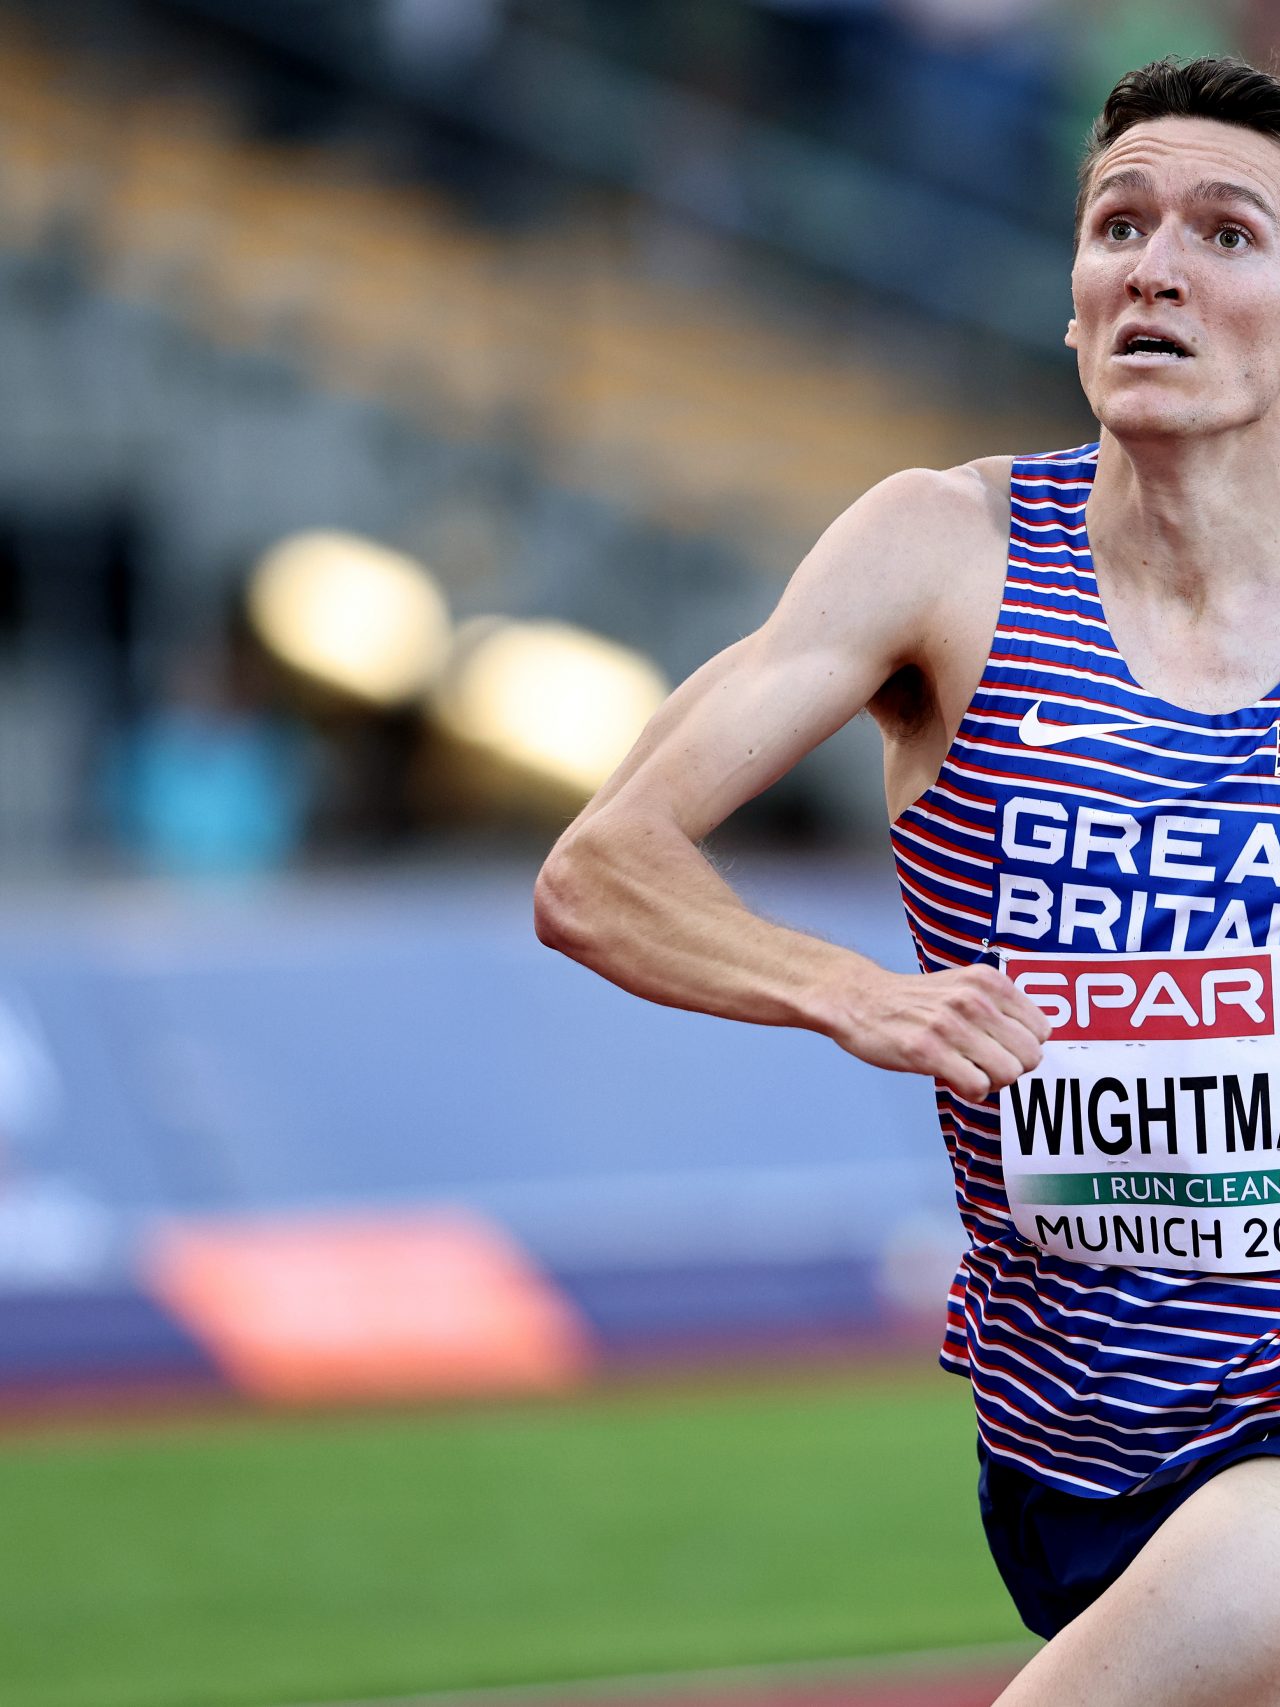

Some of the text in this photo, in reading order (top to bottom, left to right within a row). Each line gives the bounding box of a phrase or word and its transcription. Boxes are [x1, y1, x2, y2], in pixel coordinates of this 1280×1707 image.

[1013, 966, 1265, 1029] SPAR
[1092, 1179, 1100, 1200] I
[1110, 1177, 1176, 1201] RUN
[1035, 1214, 1223, 1259] MUNICH
